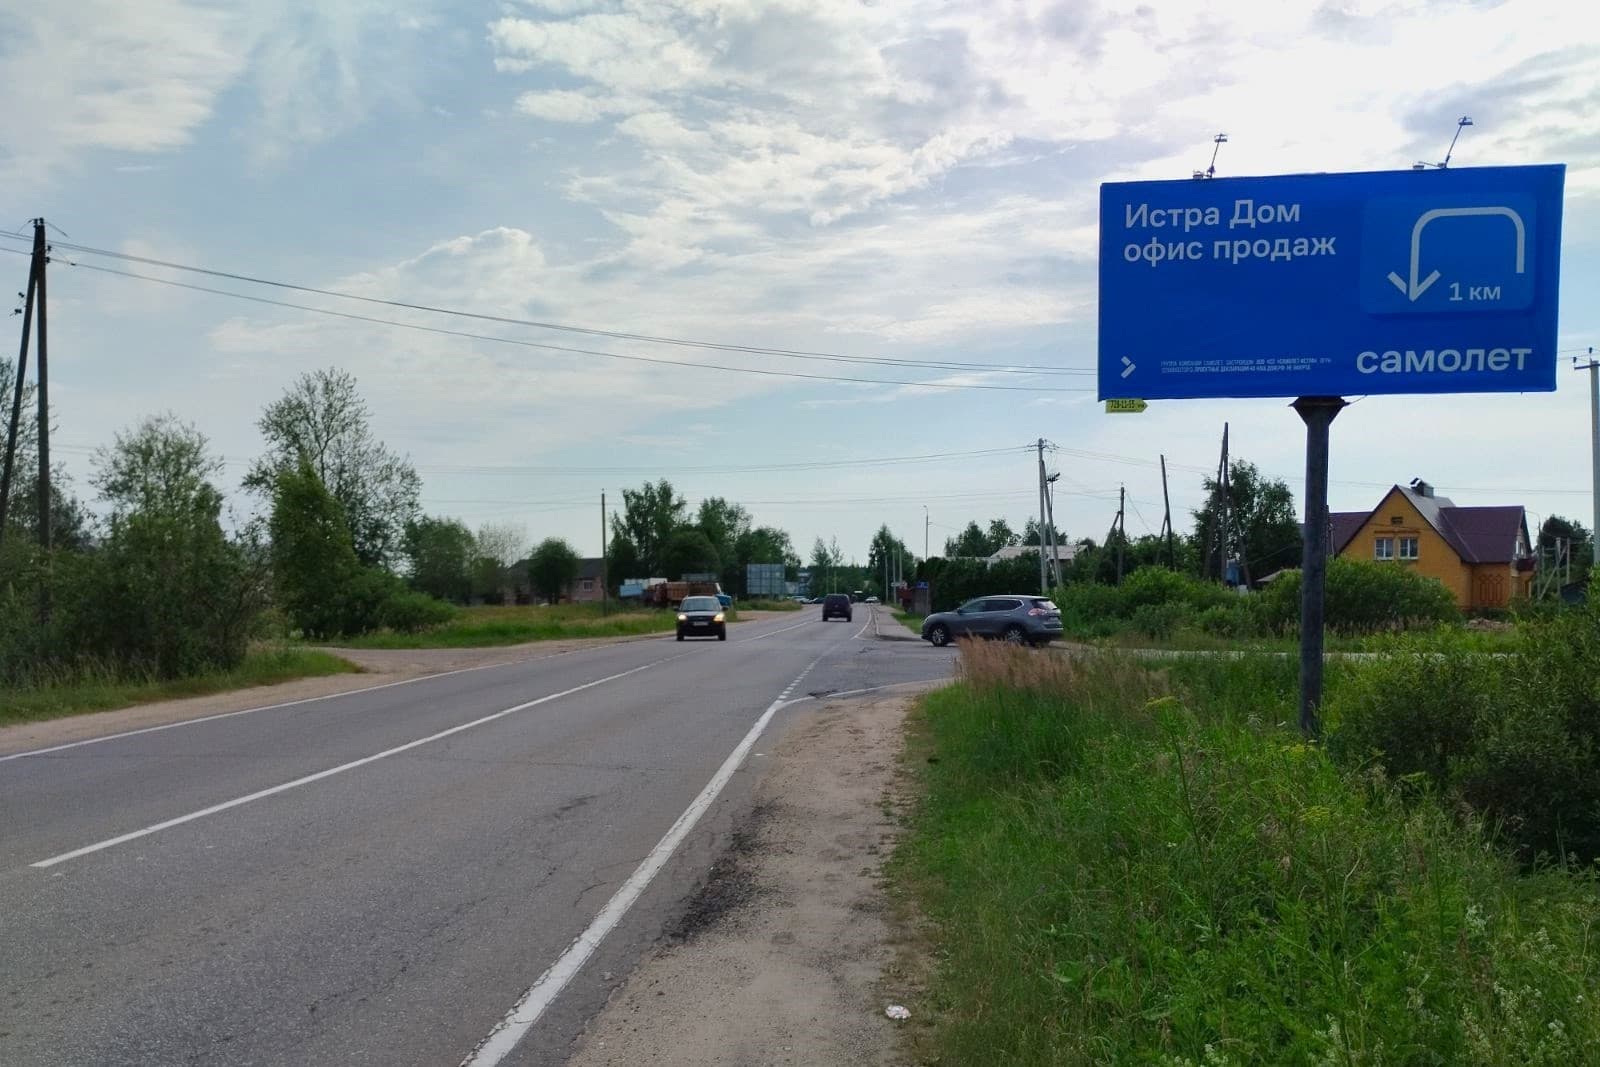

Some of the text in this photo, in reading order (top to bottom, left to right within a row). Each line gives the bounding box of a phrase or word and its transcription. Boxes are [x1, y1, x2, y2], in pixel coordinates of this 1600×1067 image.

[1125, 199, 1300, 233] Истра Дом
[1124, 236, 1337, 267] офис продаж
[1450, 283, 1502, 301] 1 км
[1356, 348, 1532, 374] самолет
